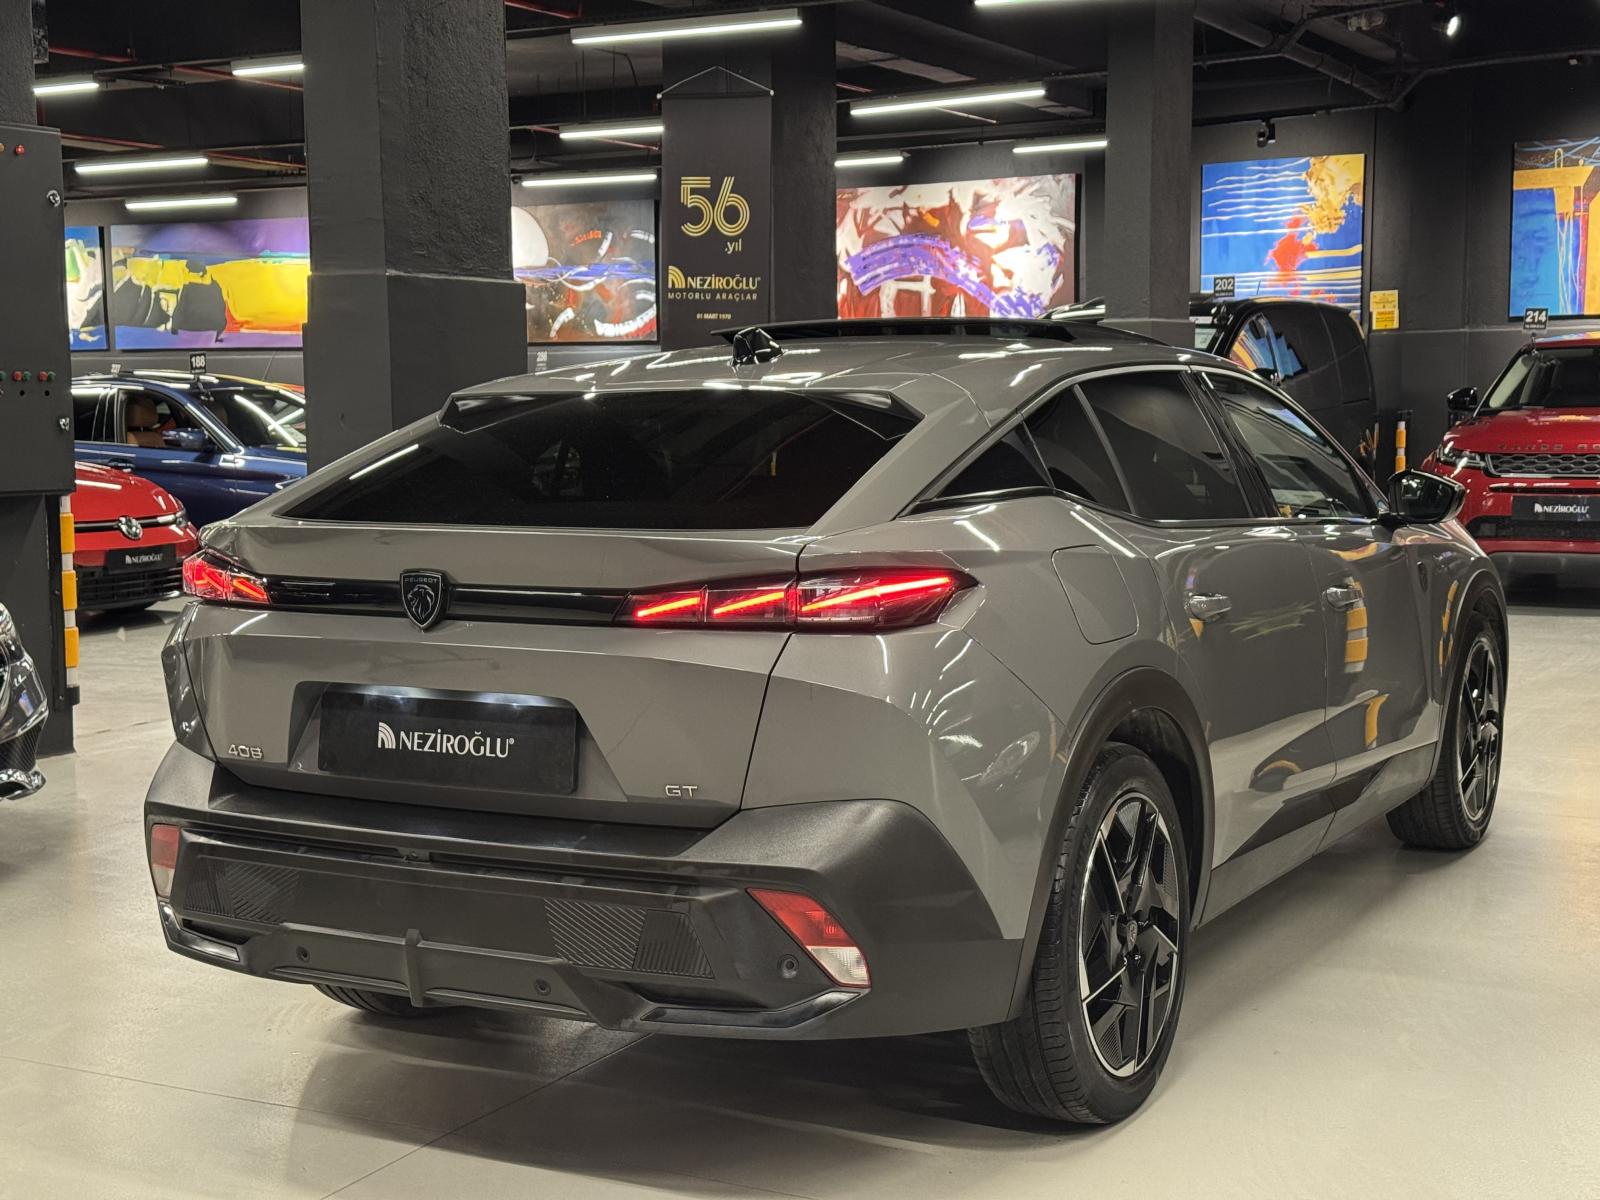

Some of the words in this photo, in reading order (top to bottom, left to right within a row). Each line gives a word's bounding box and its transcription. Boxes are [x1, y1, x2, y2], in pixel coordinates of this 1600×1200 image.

[680, 176, 750, 237] 56
[1215, 278, 1234, 290] 202
[667, 292, 712, 300] MOTORLU
[715, 292, 758, 302] ARAÇLAR
[1525, 310, 1547, 323] 214
[191, 355, 206, 368] 188
[228, 744, 262, 759] 408
[665, 784, 698, 798] GT
